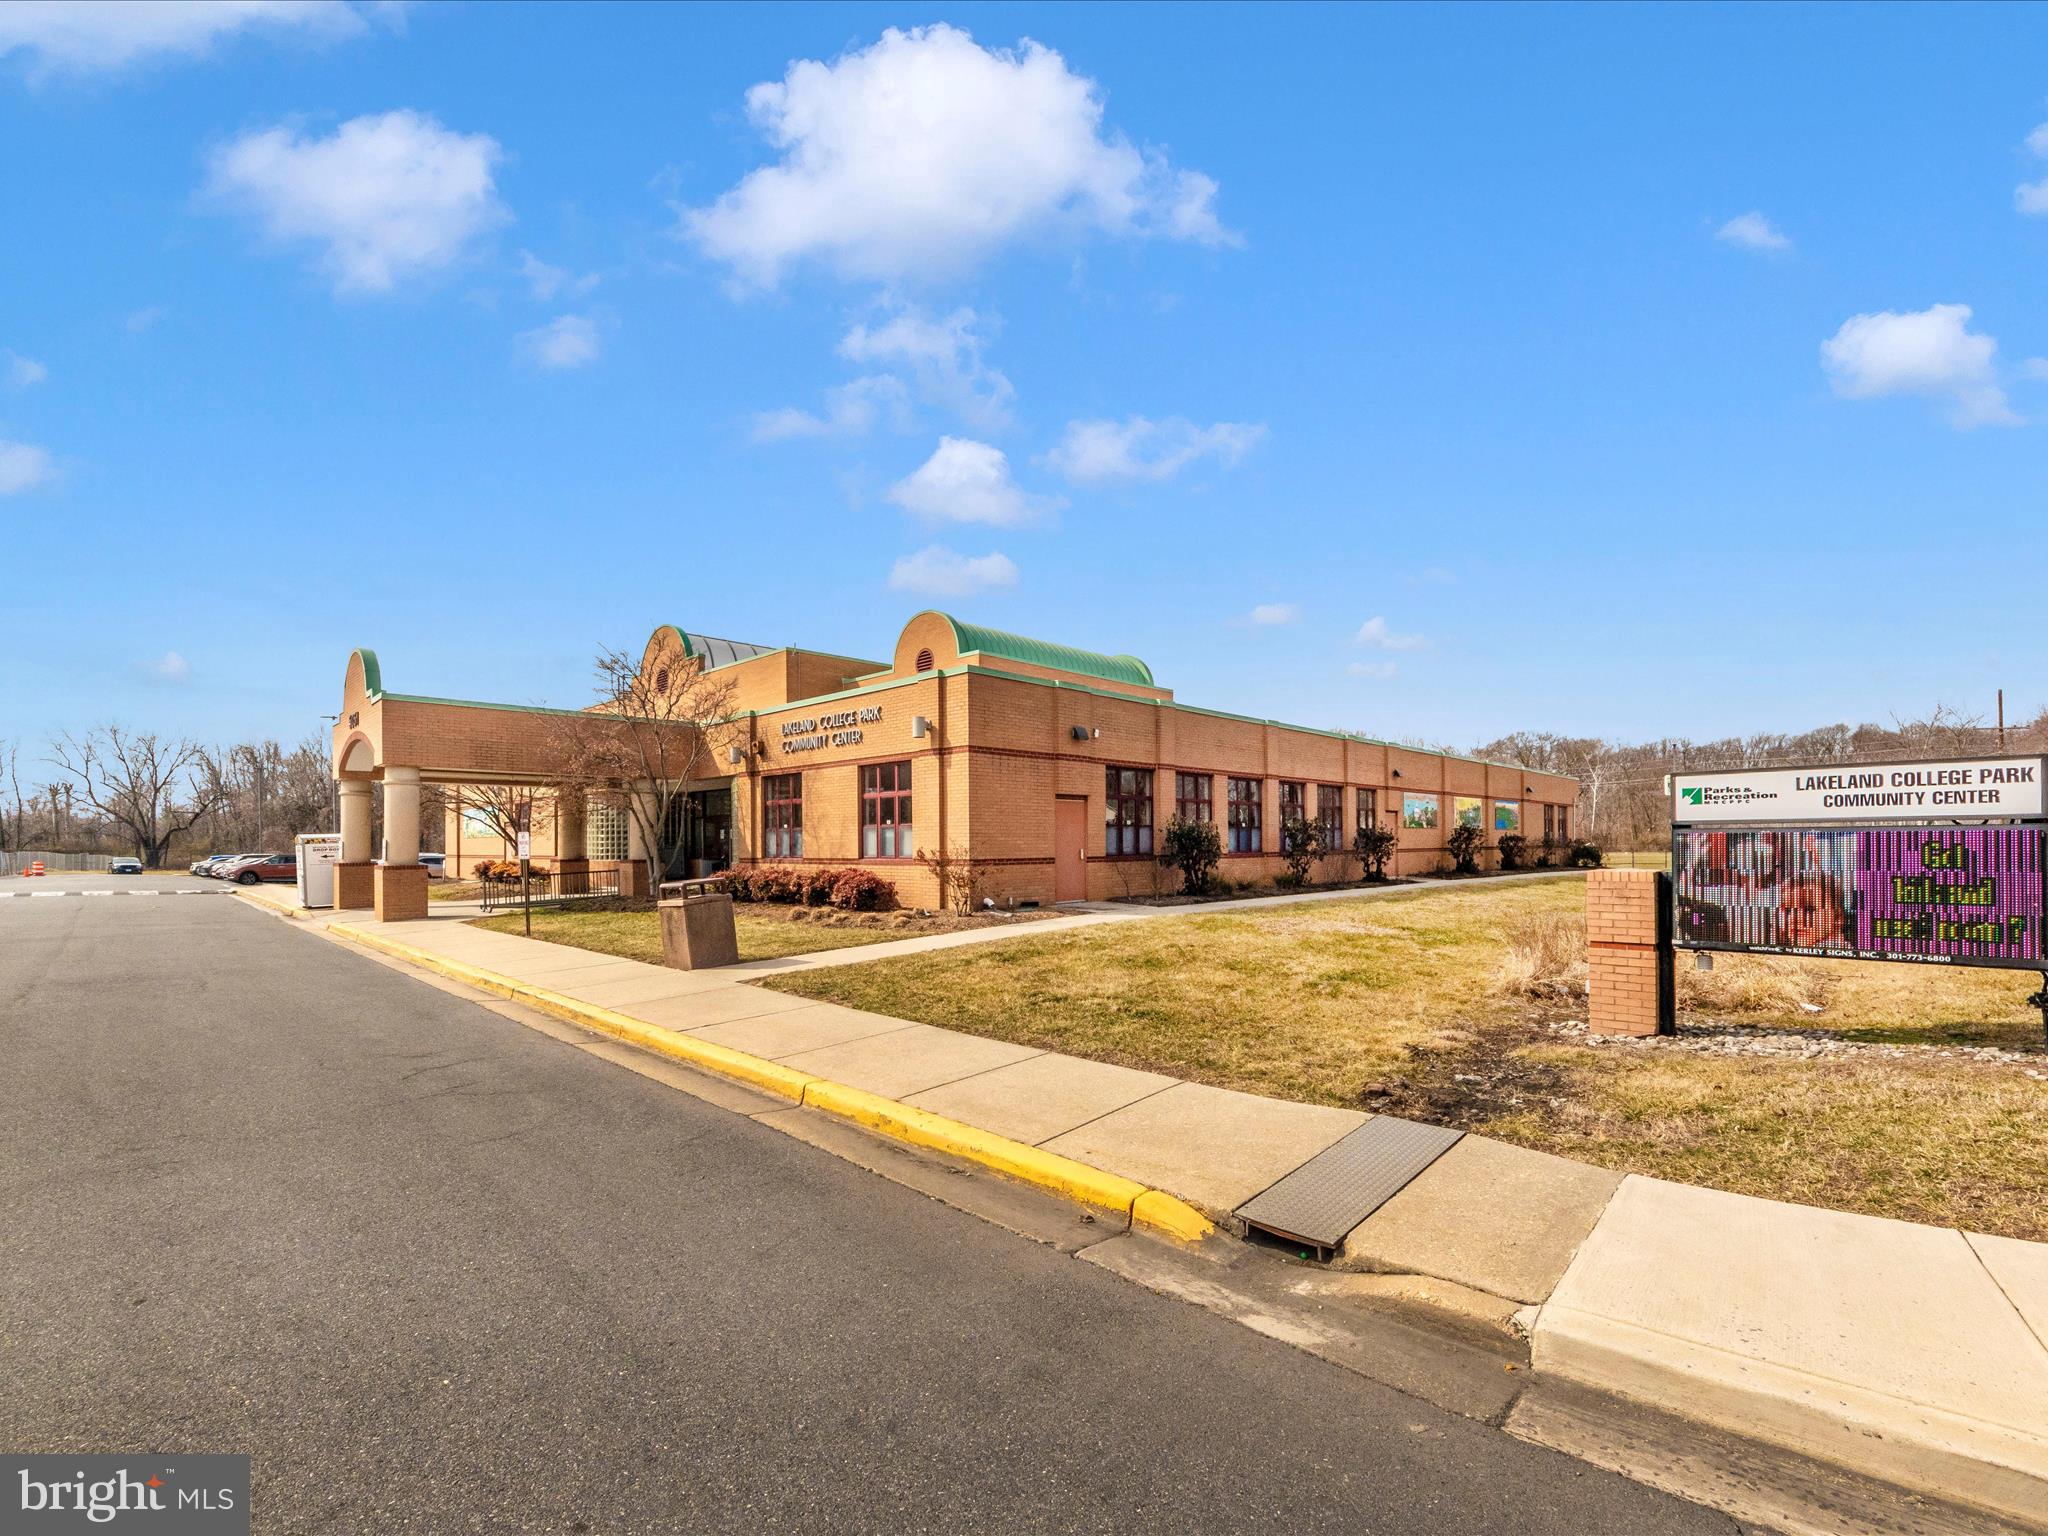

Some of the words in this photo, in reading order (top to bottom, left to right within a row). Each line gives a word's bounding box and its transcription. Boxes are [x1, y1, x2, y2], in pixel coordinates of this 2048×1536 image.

[782, 719, 816, 736] LAKELAND
[820, 710, 857, 729] COLLEGE
[860, 705, 882, 721] PARK
[782, 734, 828, 753] COMMUNITY
[832, 729, 863, 746] CENTER
[1795, 773, 1885, 791] LAKELAND
[1890, 769, 1973, 788] COLLEGE
[1979, 767, 2035, 784] PARK
[1704, 786, 1741, 794] Parks
[1704, 791, 1778, 801] Recreation
[1823, 791, 1926, 808] COMMUNITY
[1932, 789, 2001, 805] CENTER
[1793, 947, 1824, 956] KERLEY
[1859, 951, 1880, 959] INC.
[1886, 952, 1952, 963] 301-773-6800
